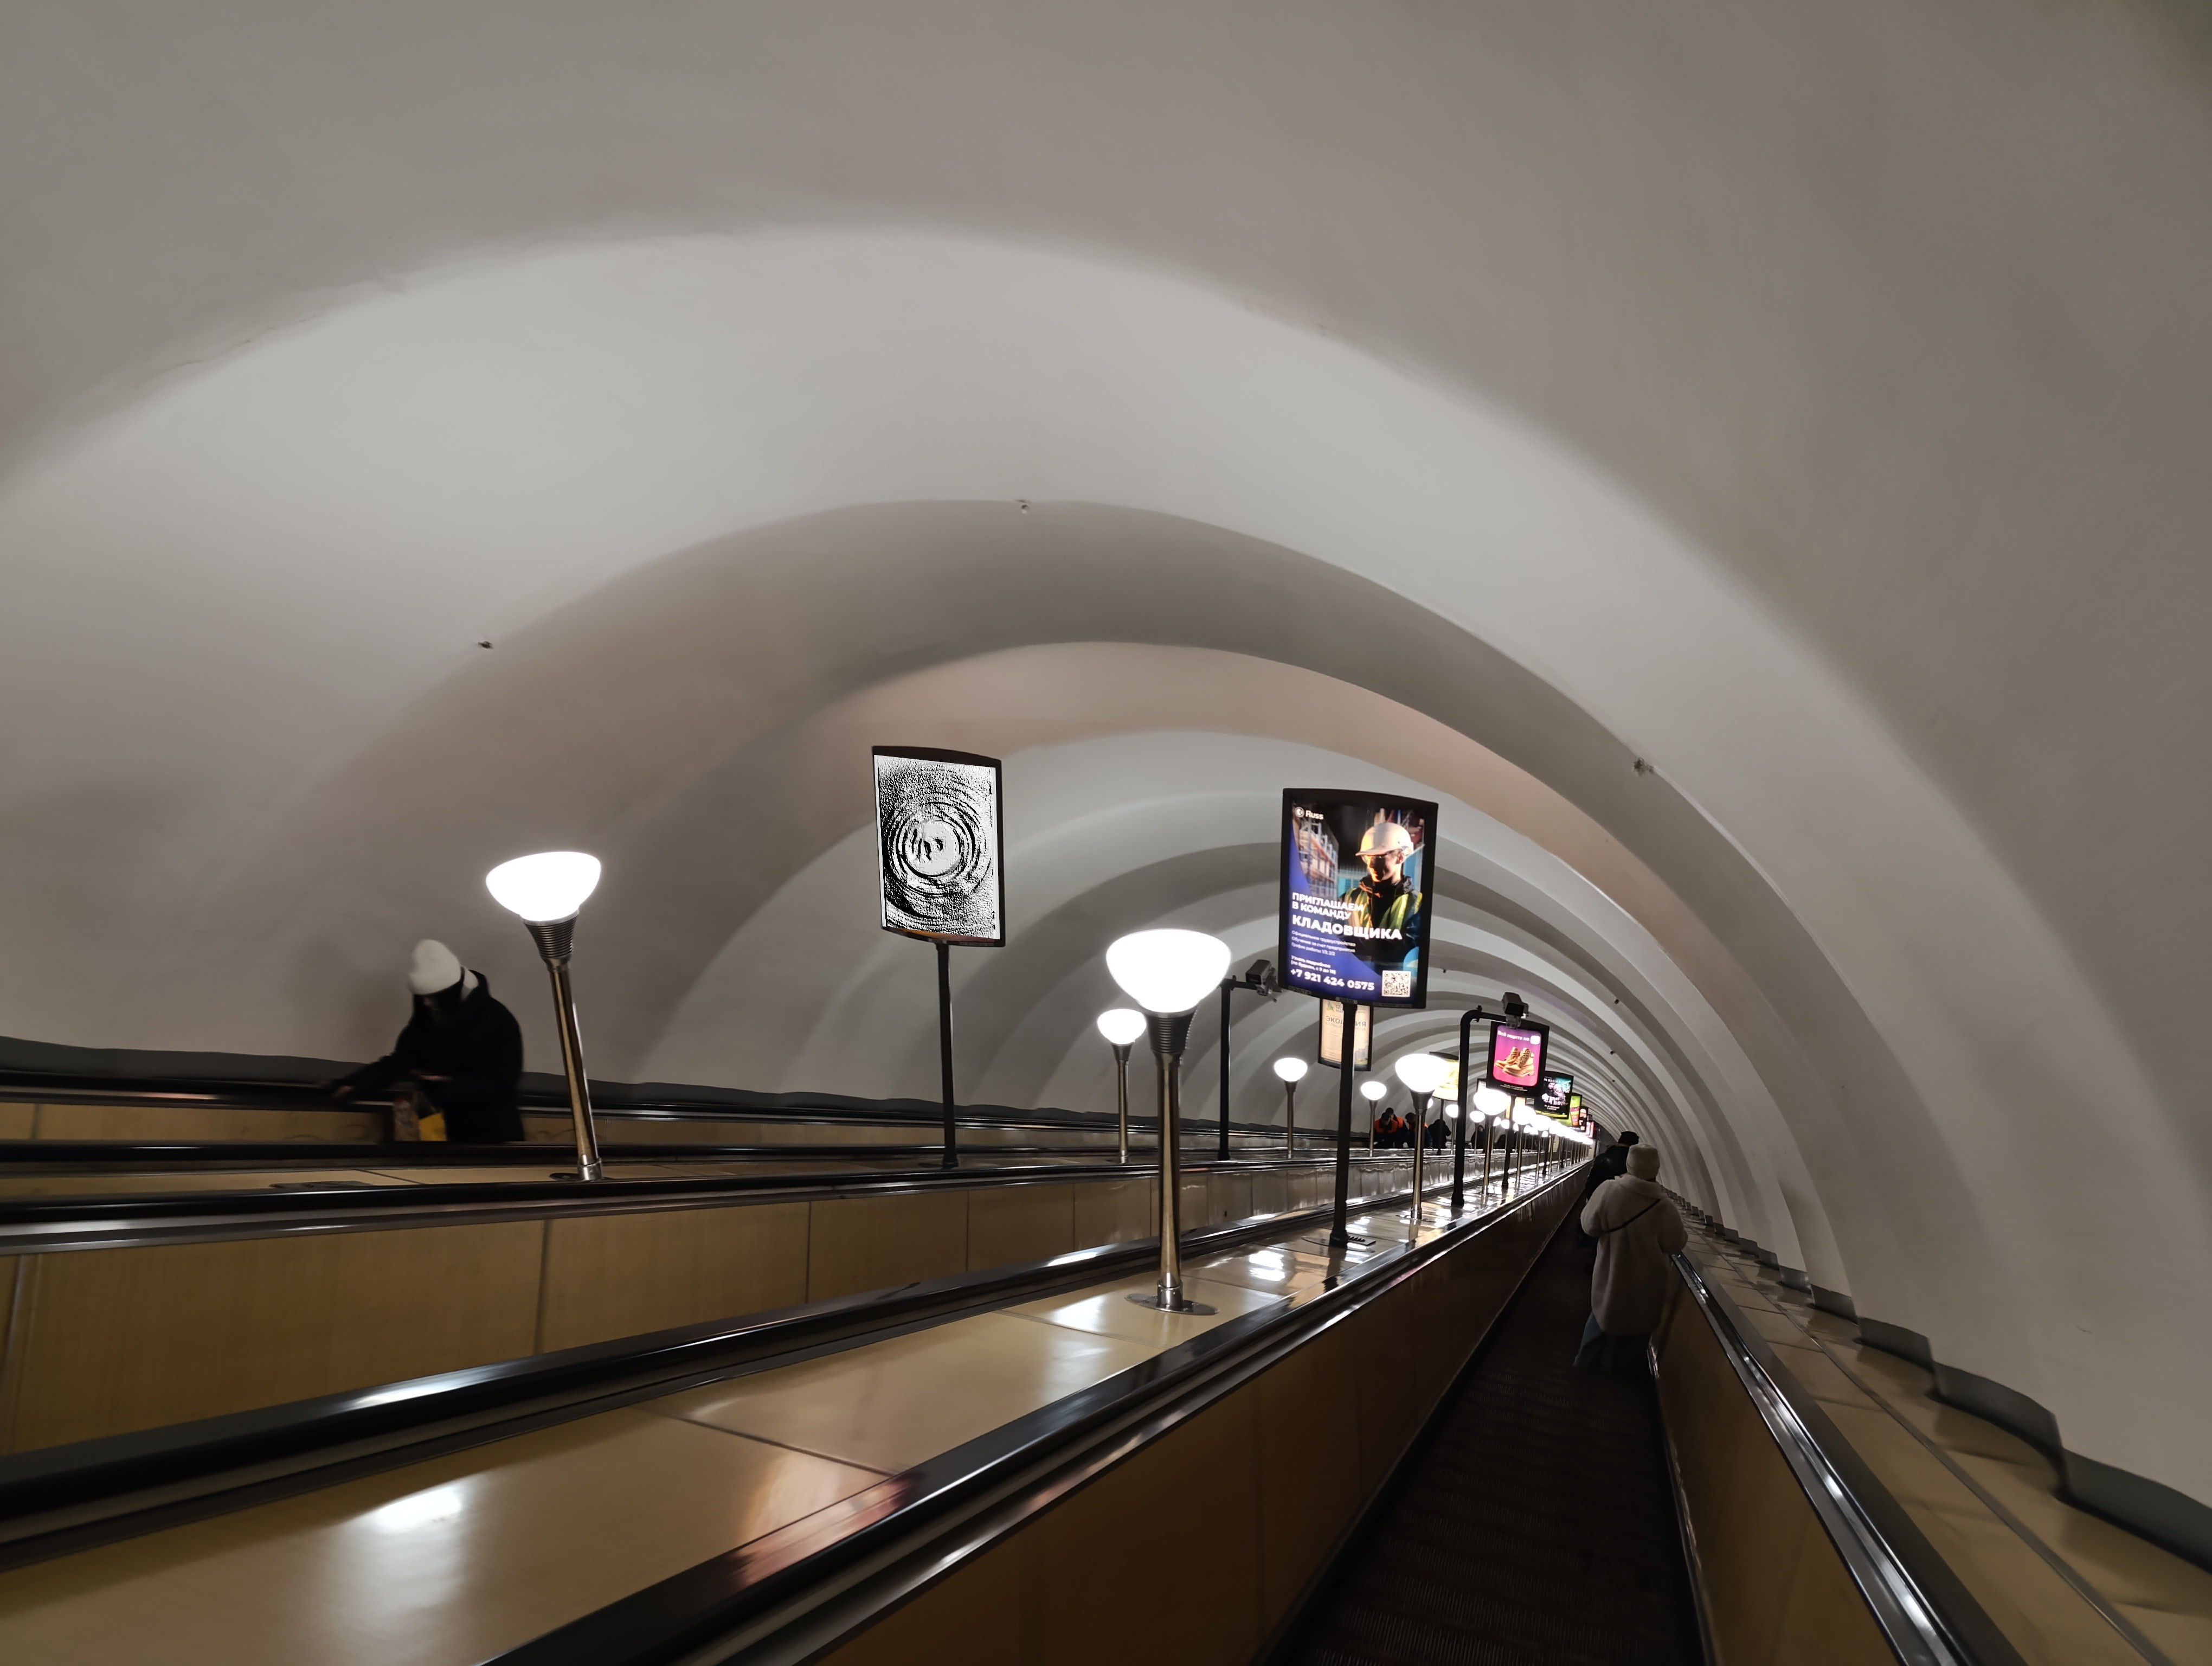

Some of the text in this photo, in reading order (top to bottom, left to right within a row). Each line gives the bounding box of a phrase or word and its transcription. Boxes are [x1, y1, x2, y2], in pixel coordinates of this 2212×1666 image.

[1306, 810, 1323, 819] Russ
[1293, 892, 1364, 912] ПРИГЛАШАЕМ
[1301, 903, 1352, 920] КОМАНДУ
[1293, 915, 1403, 939] КЛАДОВЩИКА
[1290, 969, 1374, 991] +7 921 424 0575
